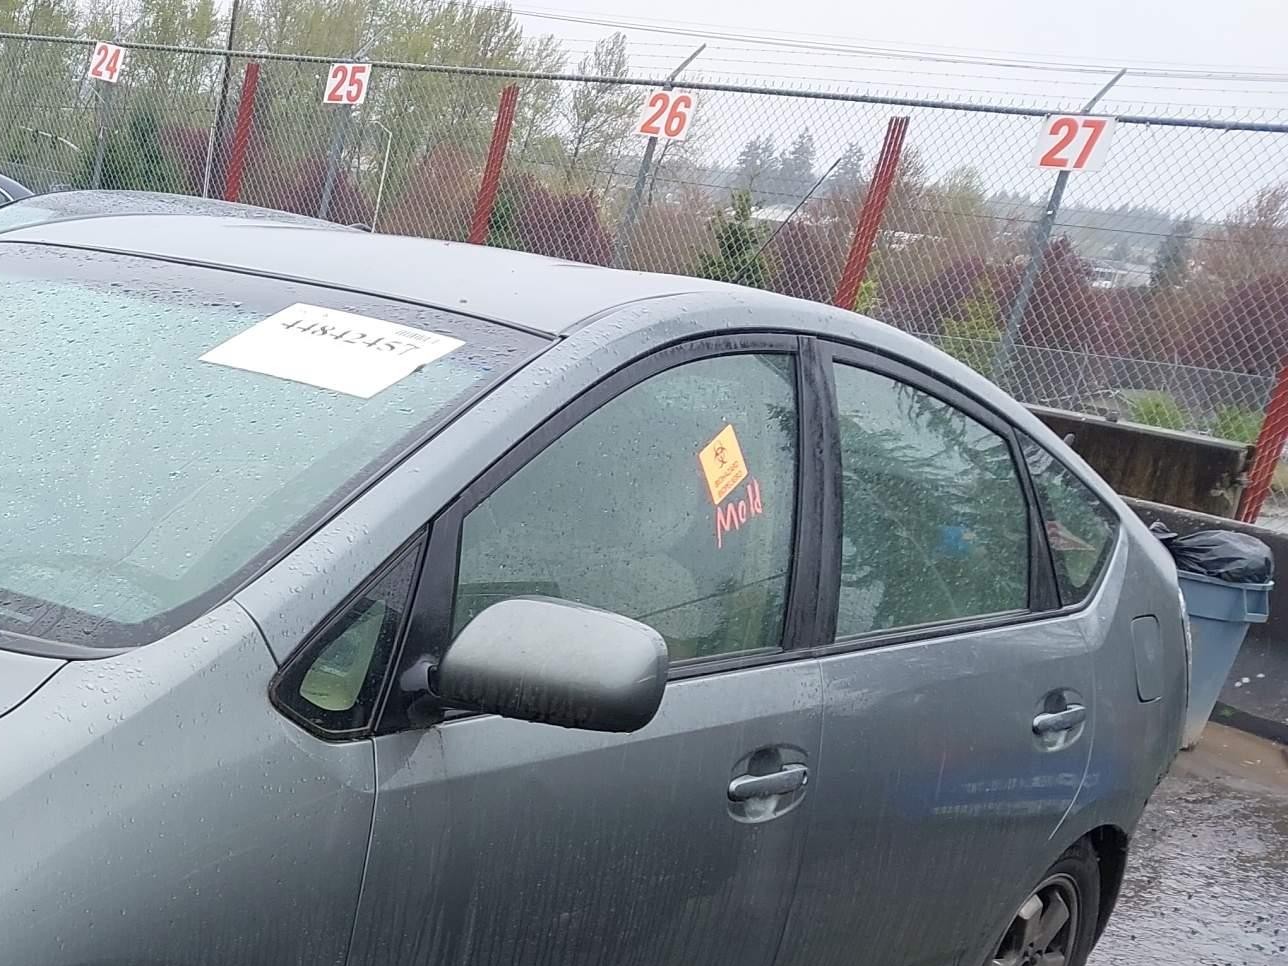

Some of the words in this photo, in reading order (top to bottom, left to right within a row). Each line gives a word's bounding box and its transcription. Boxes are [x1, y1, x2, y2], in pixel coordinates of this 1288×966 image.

[91, 44, 121, 80] 24
[327, 65, 369, 103] 25
[640, 92, 692, 138] 26
[1039, 117, 1107, 169] 27
[280, 319, 421, 355] 44842457
[716, 477, 763, 549] Mold
